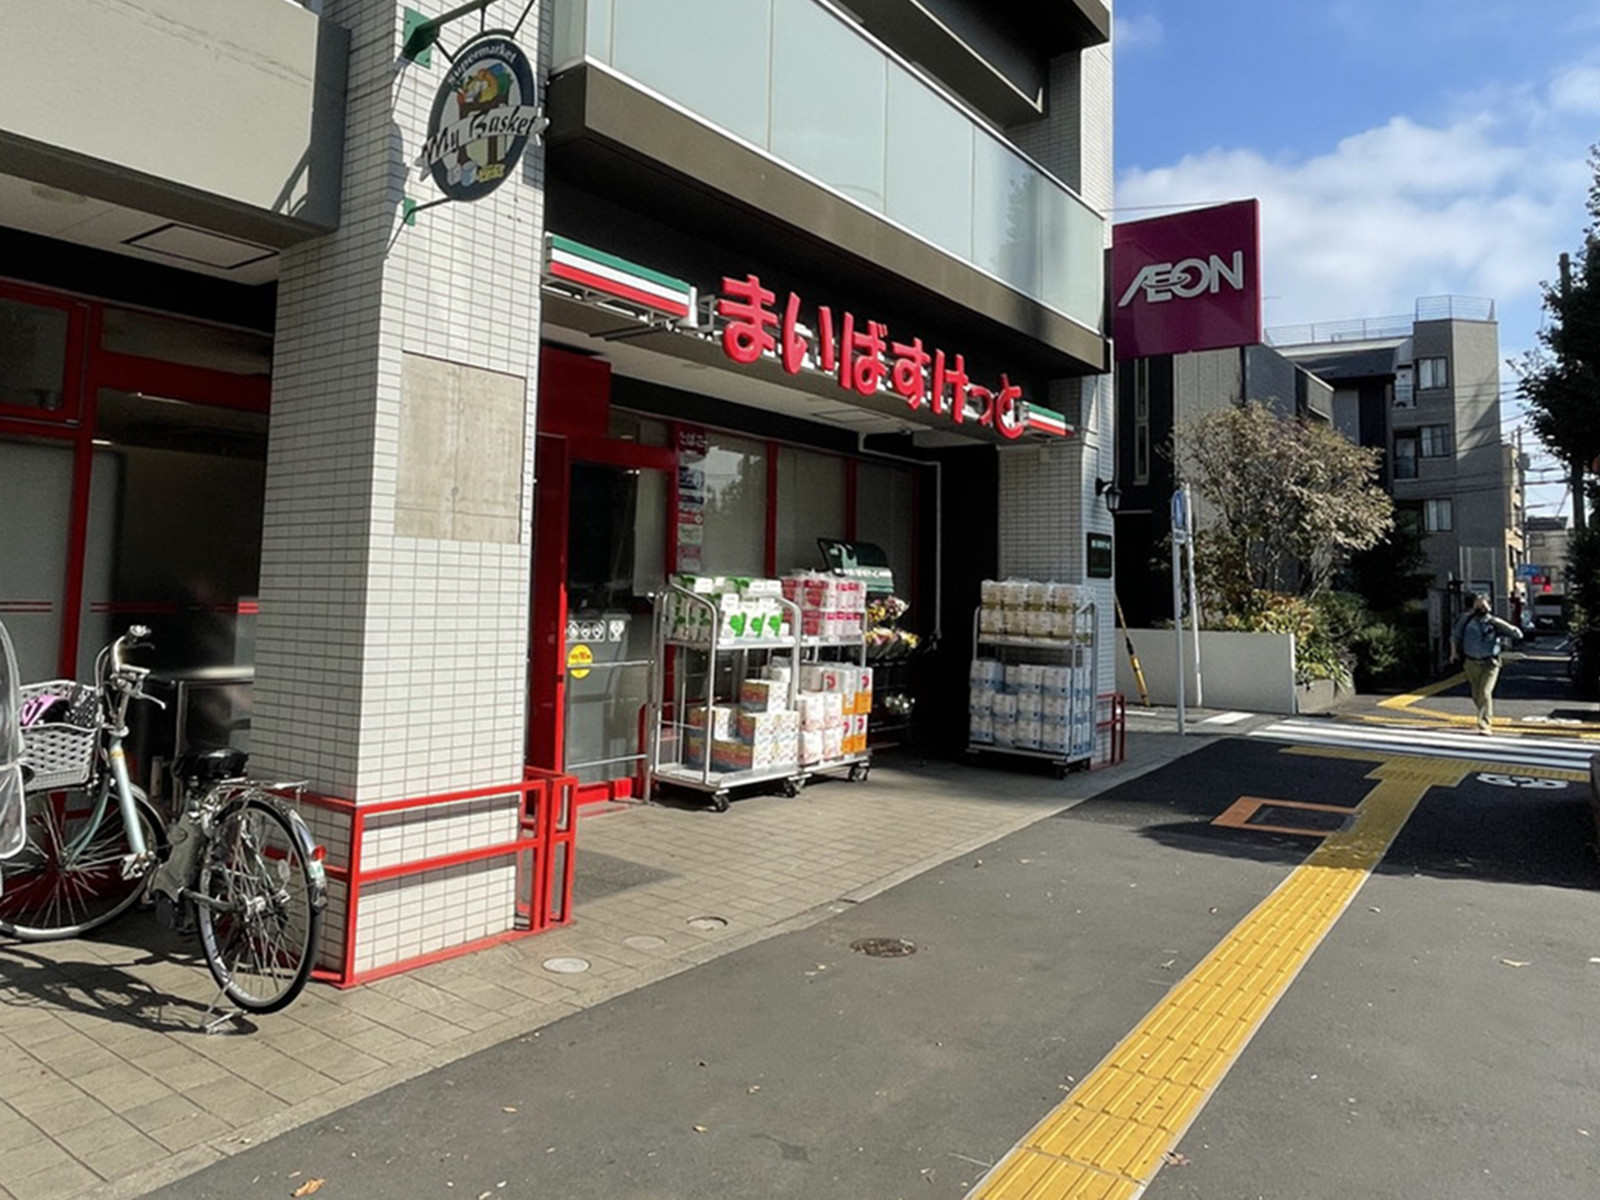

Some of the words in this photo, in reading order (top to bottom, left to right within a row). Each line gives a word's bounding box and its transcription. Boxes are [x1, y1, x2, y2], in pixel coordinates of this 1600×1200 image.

[421, 126, 462, 163] My
[468, 106, 537, 139] Basket
[1118, 251, 1243, 307] AEON
[717, 274, 1024, 439] まいばすけっと
